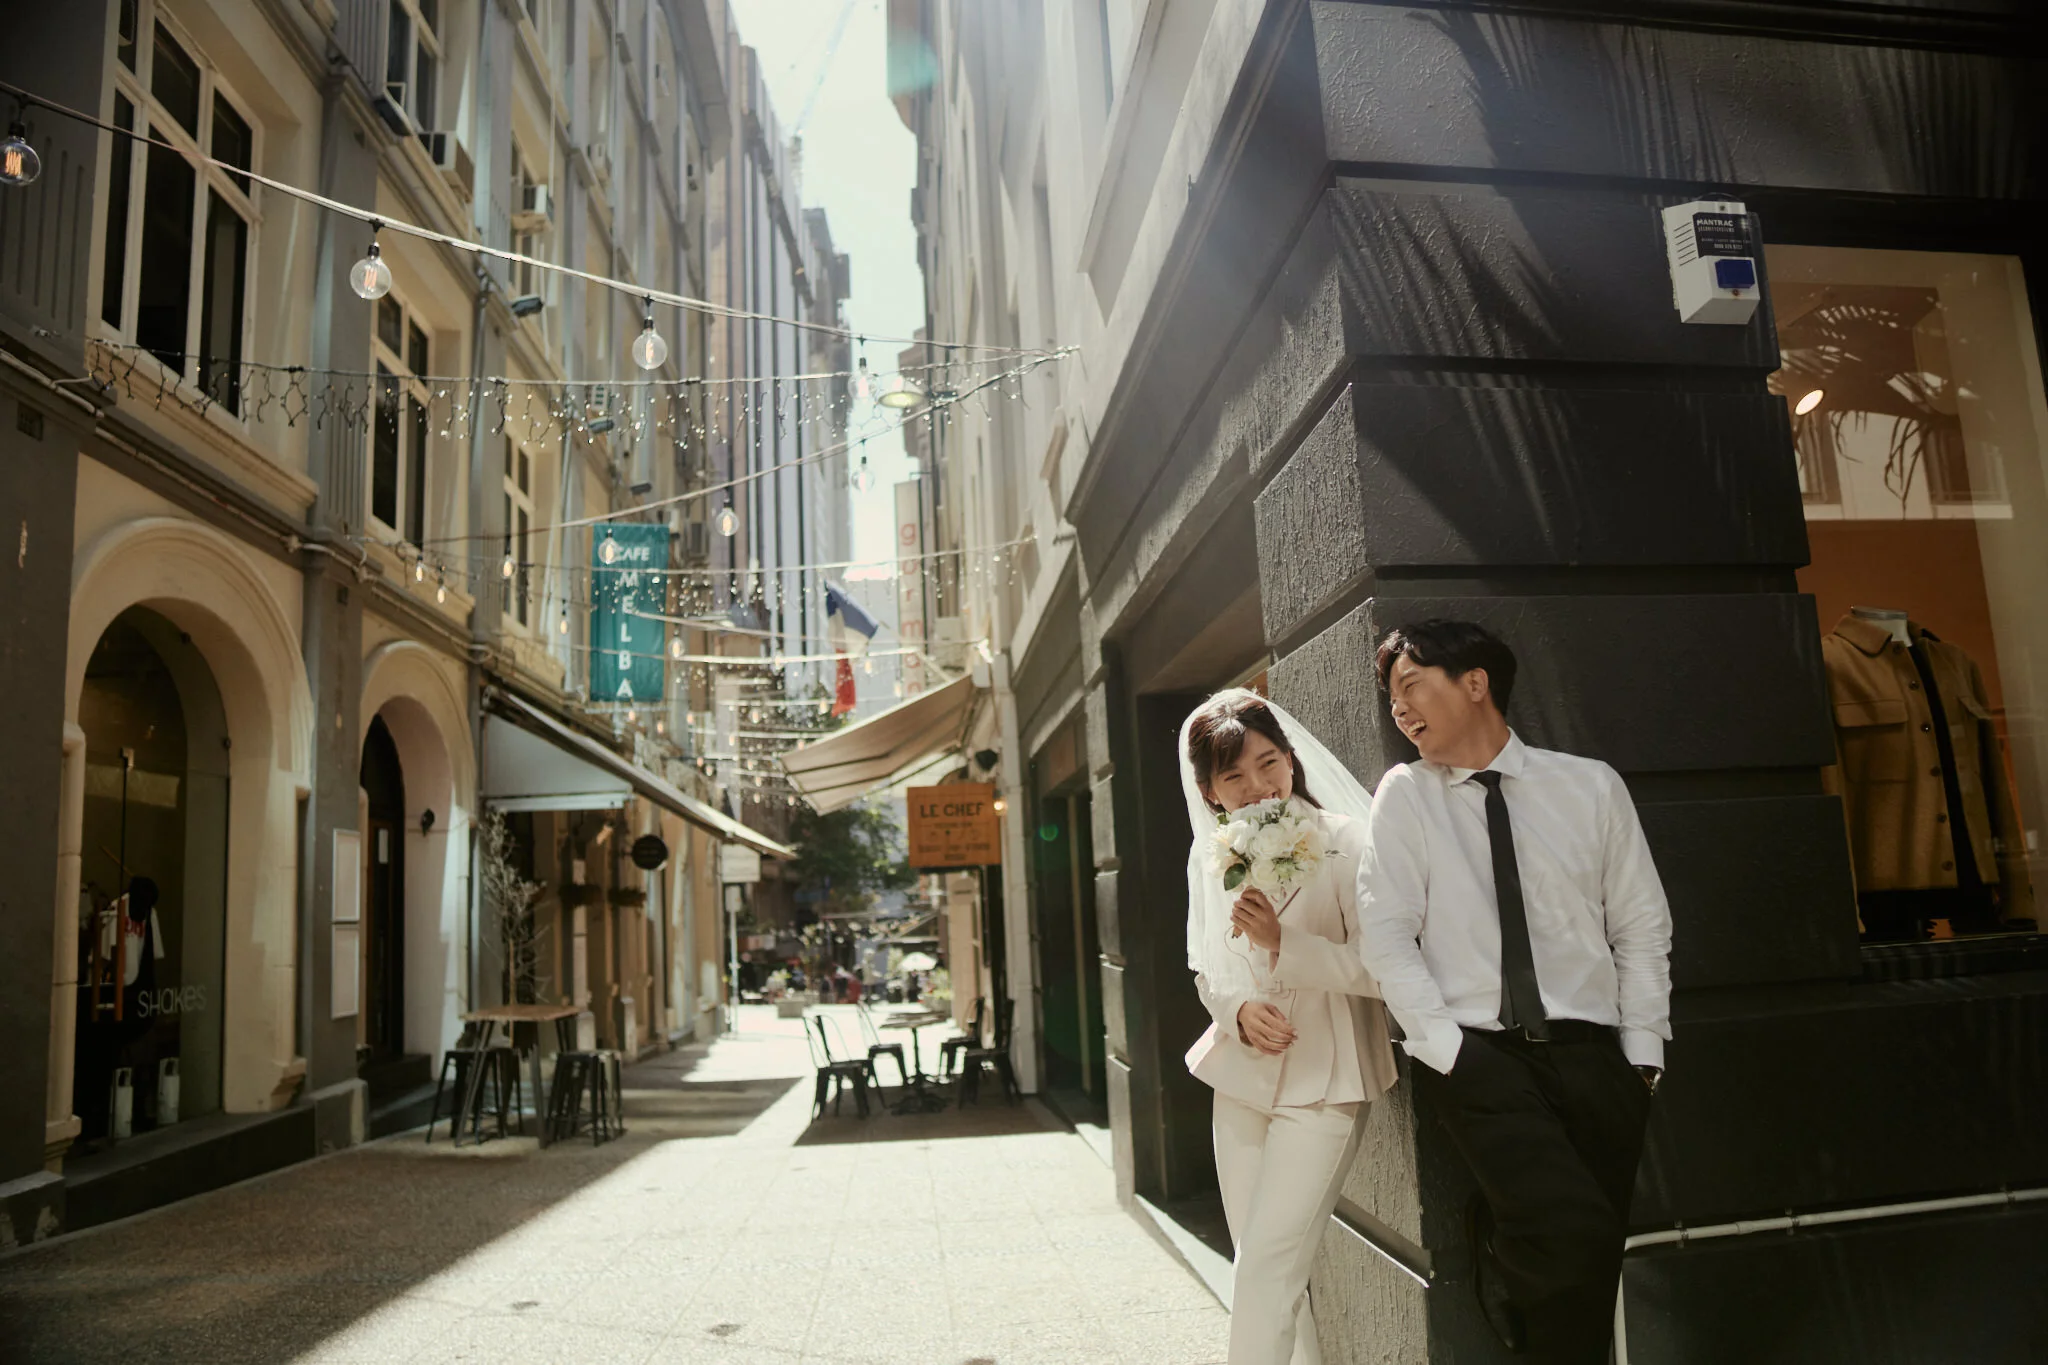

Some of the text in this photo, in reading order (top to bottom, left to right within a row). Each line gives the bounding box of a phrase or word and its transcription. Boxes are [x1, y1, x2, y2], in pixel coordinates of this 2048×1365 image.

[1697, 219, 1734, 227] MANTRAC
[900, 522, 923, 697] gorman
[920, 802, 984, 818] LE CHEF
